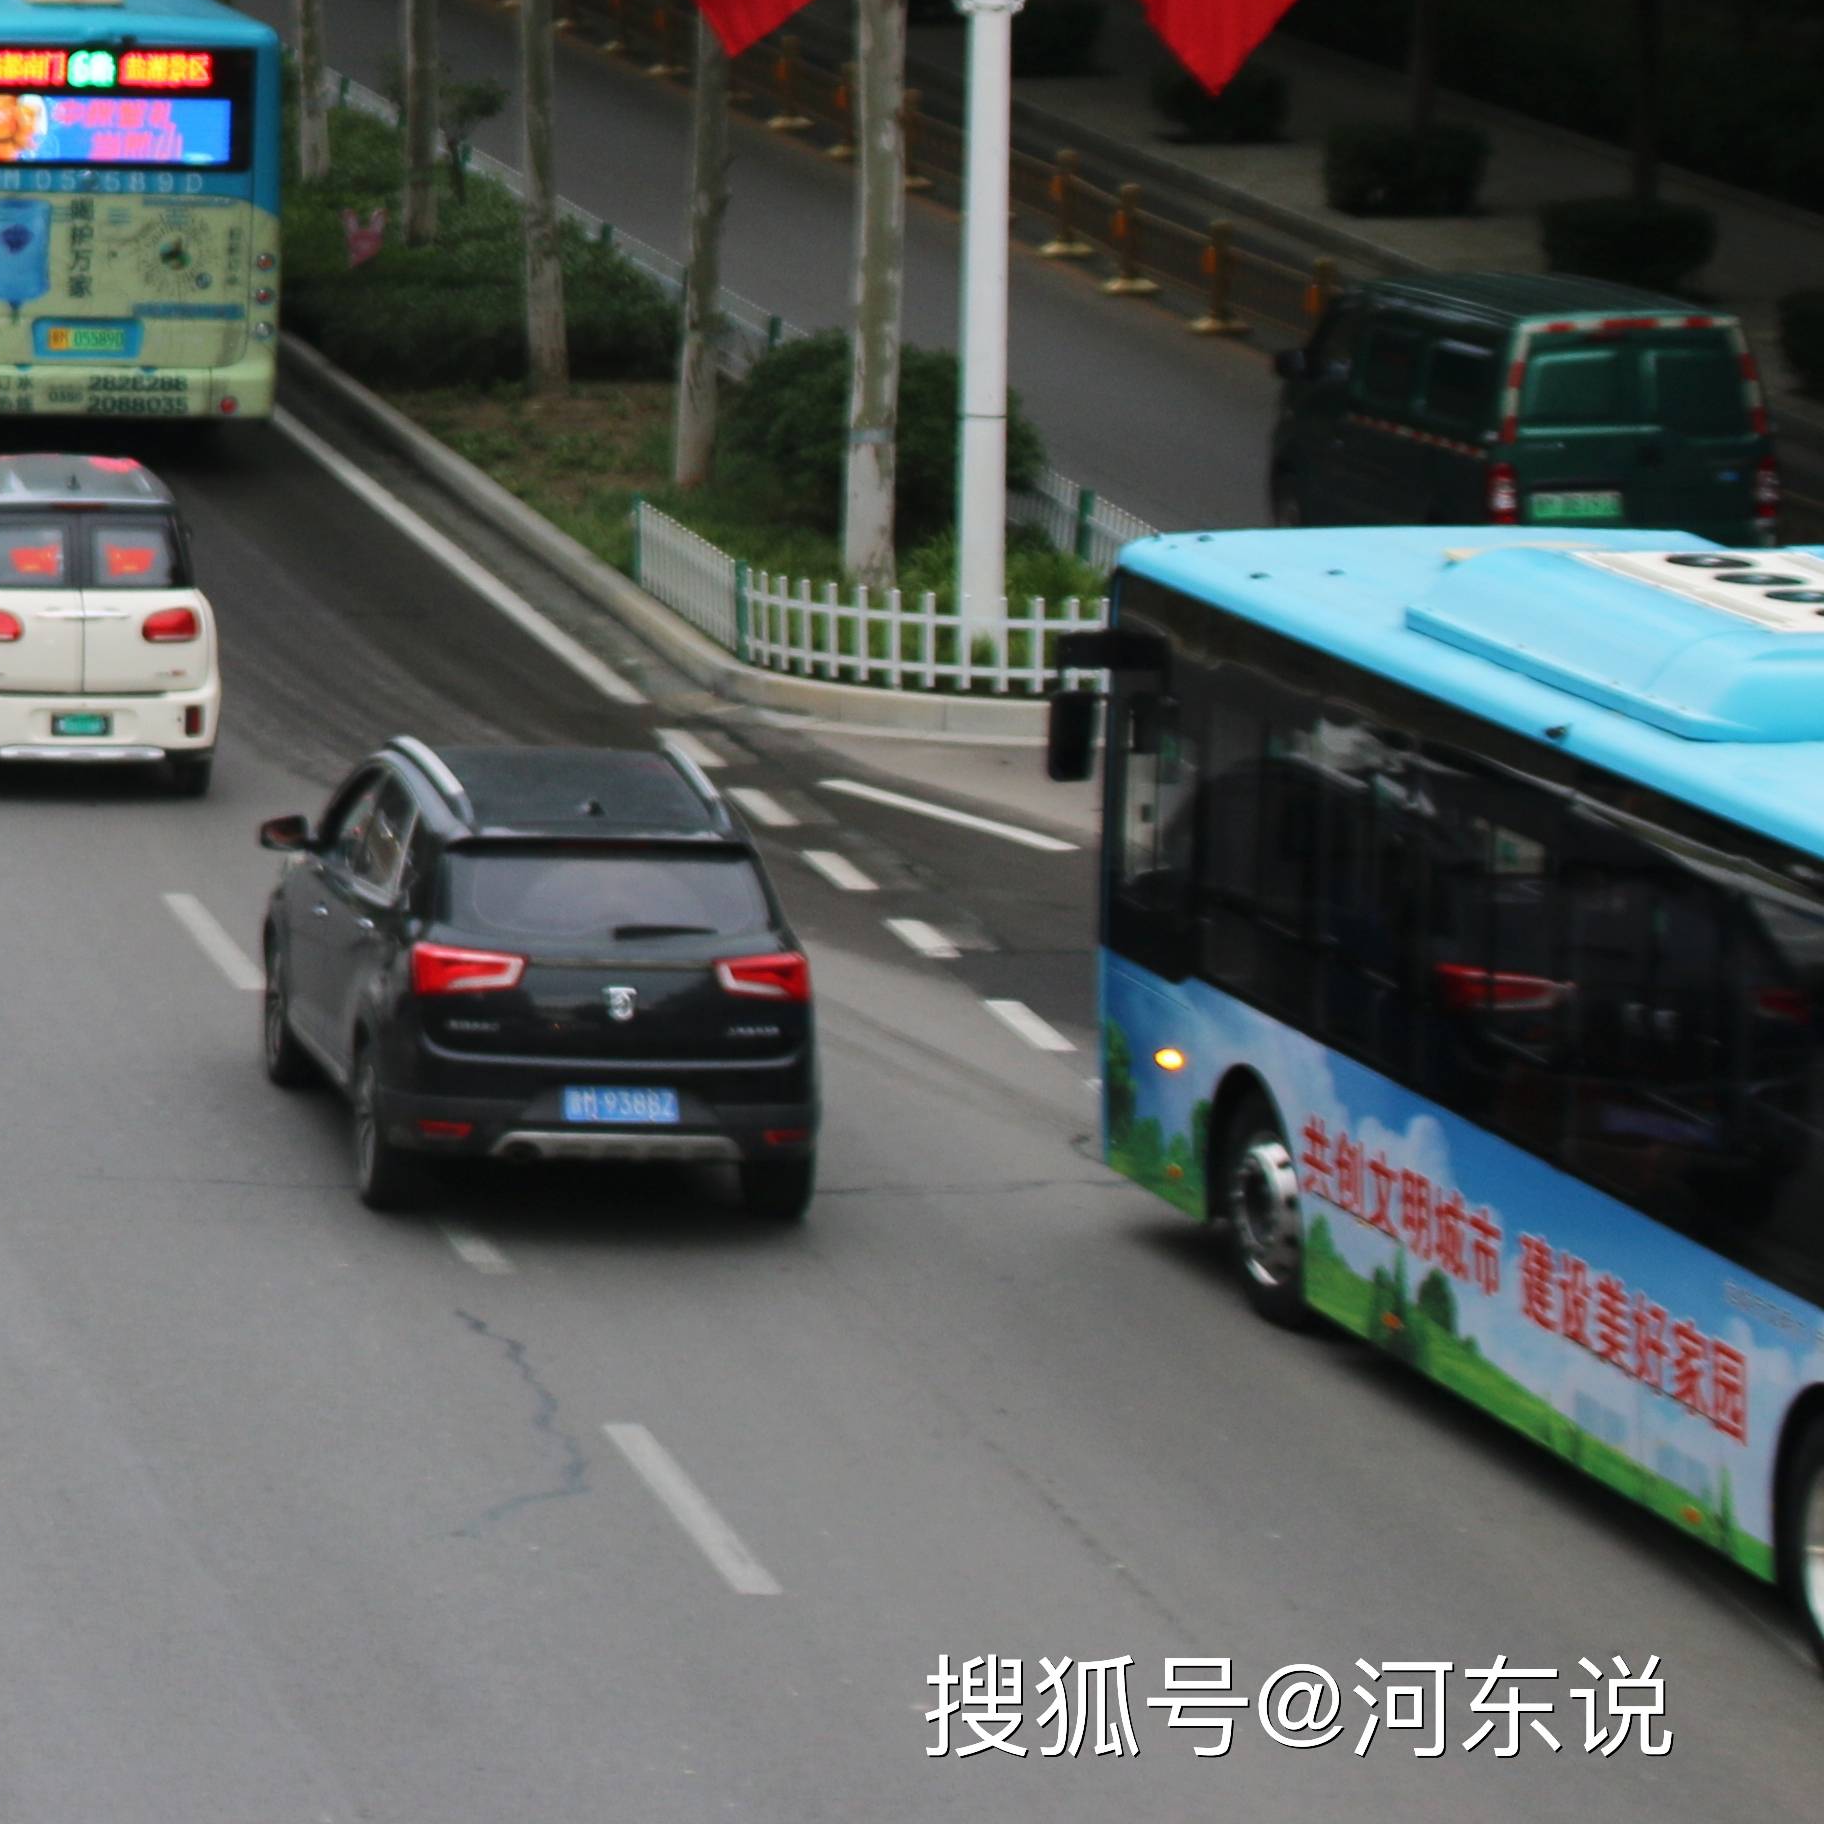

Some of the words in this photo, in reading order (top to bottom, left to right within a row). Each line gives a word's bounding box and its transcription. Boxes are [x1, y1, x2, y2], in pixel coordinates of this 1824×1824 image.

[1300, 1114, 1502, 1296] 共创文明城市
[1519, 1231, 1749, 1447] 建设美好家园
